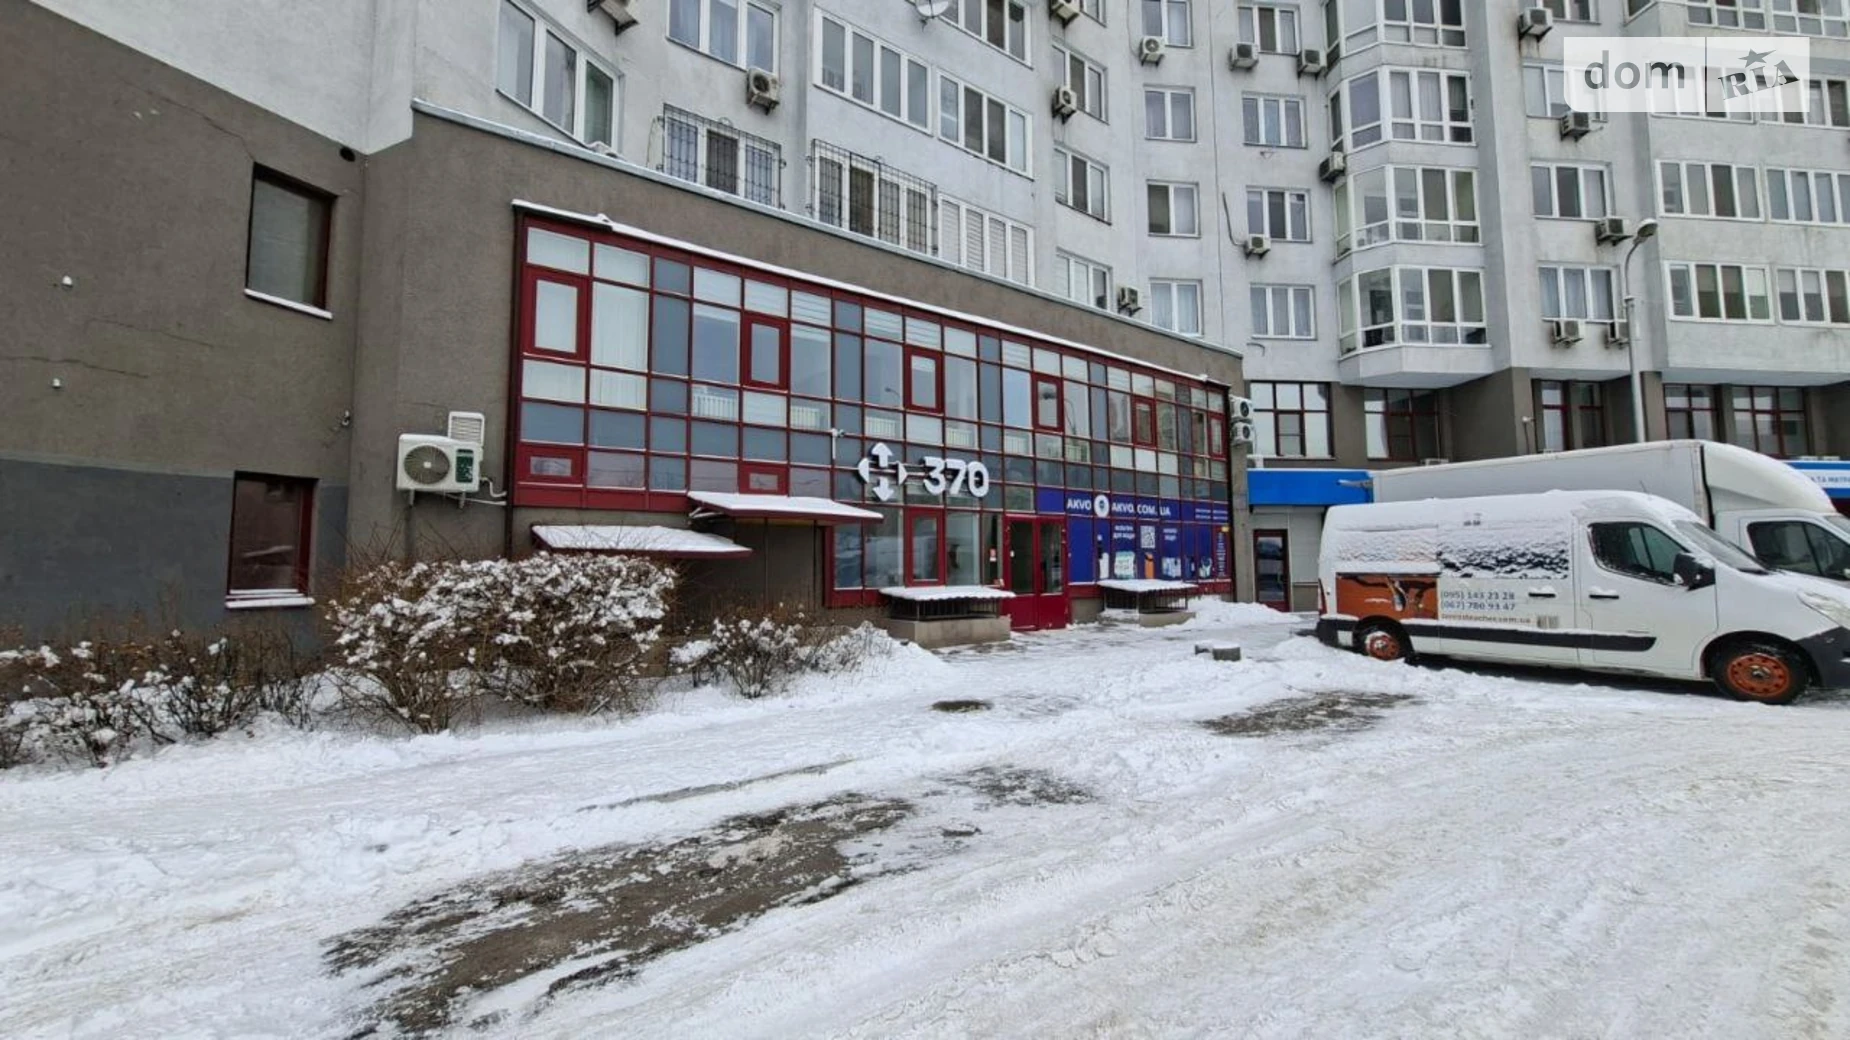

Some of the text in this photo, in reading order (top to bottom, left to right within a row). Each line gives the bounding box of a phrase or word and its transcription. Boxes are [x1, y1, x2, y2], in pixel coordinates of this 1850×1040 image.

[922, 456, 989, 498] 370
[1066, 498, 1092, 511] AKVO
[1502, 602, 1516, 611] 47
